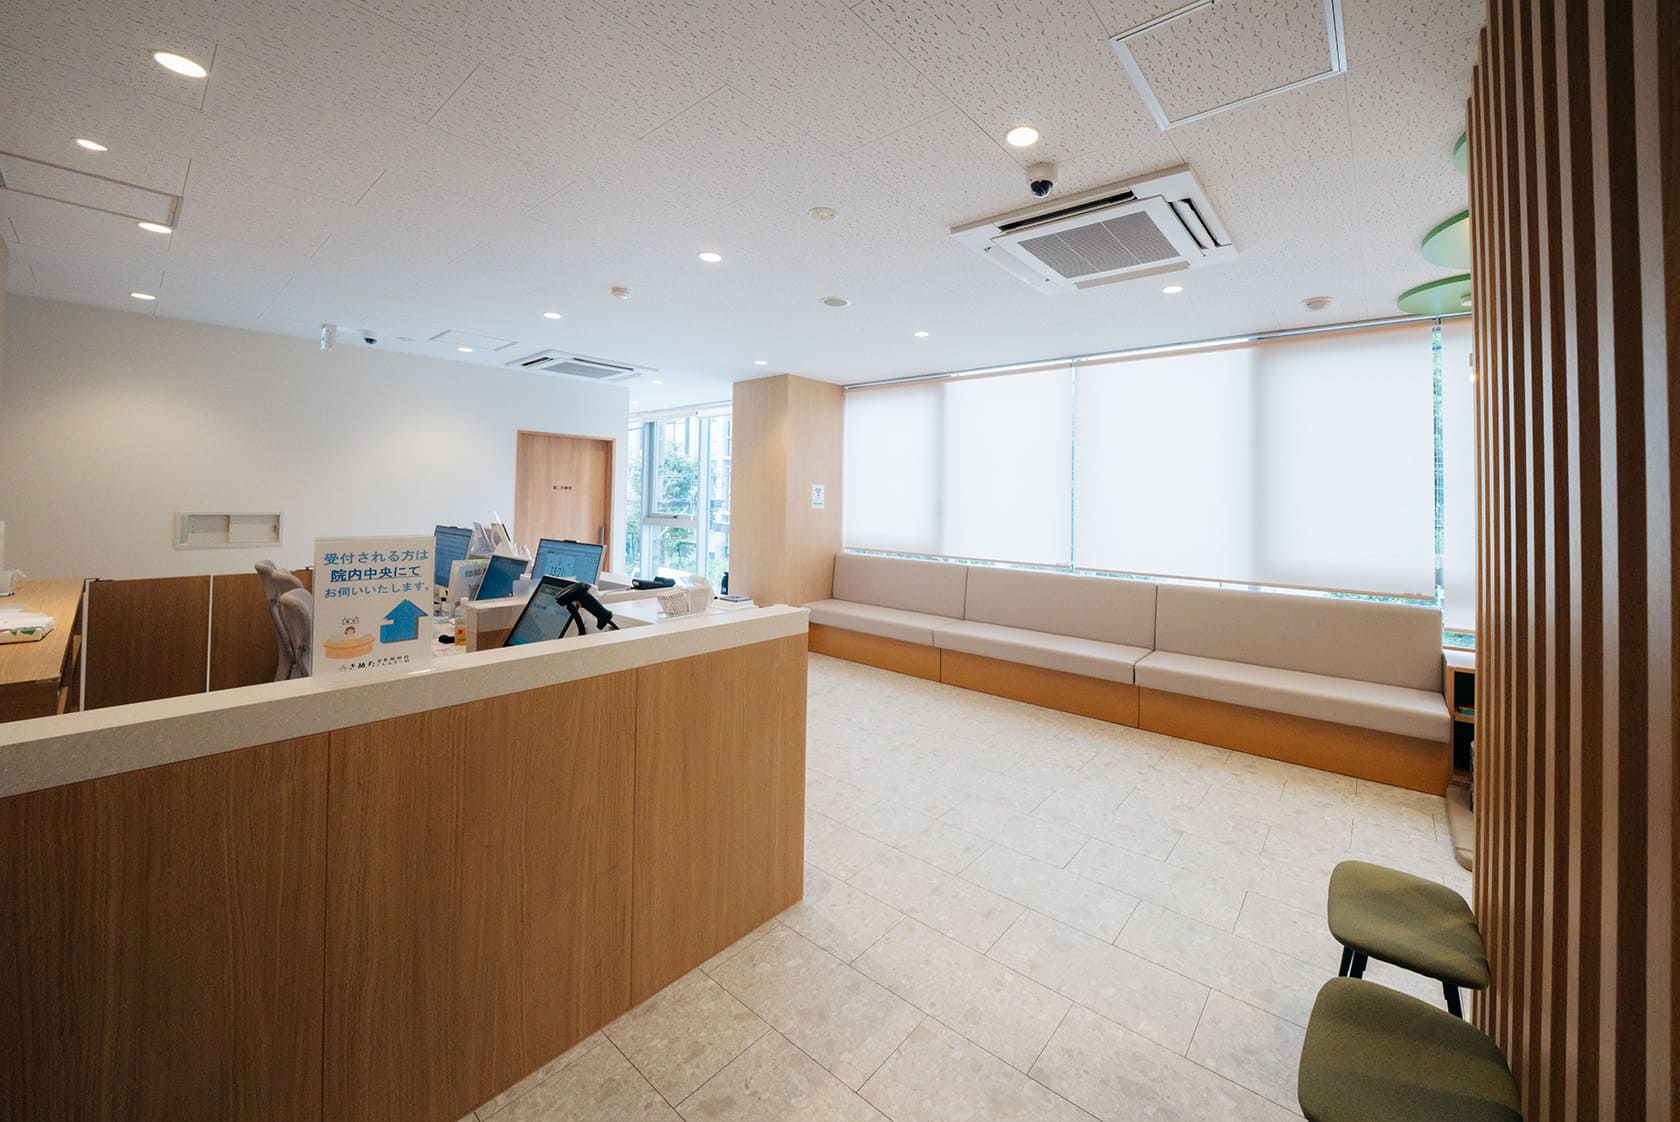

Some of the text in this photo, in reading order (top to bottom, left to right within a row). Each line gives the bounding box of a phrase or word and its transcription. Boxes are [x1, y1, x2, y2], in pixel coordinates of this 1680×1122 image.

[324, 549, 428, 566] 受付される方は
[330, 565, 421, 582] 院内中央にて
[324, 581, 429, 598] お伺いいたします。
